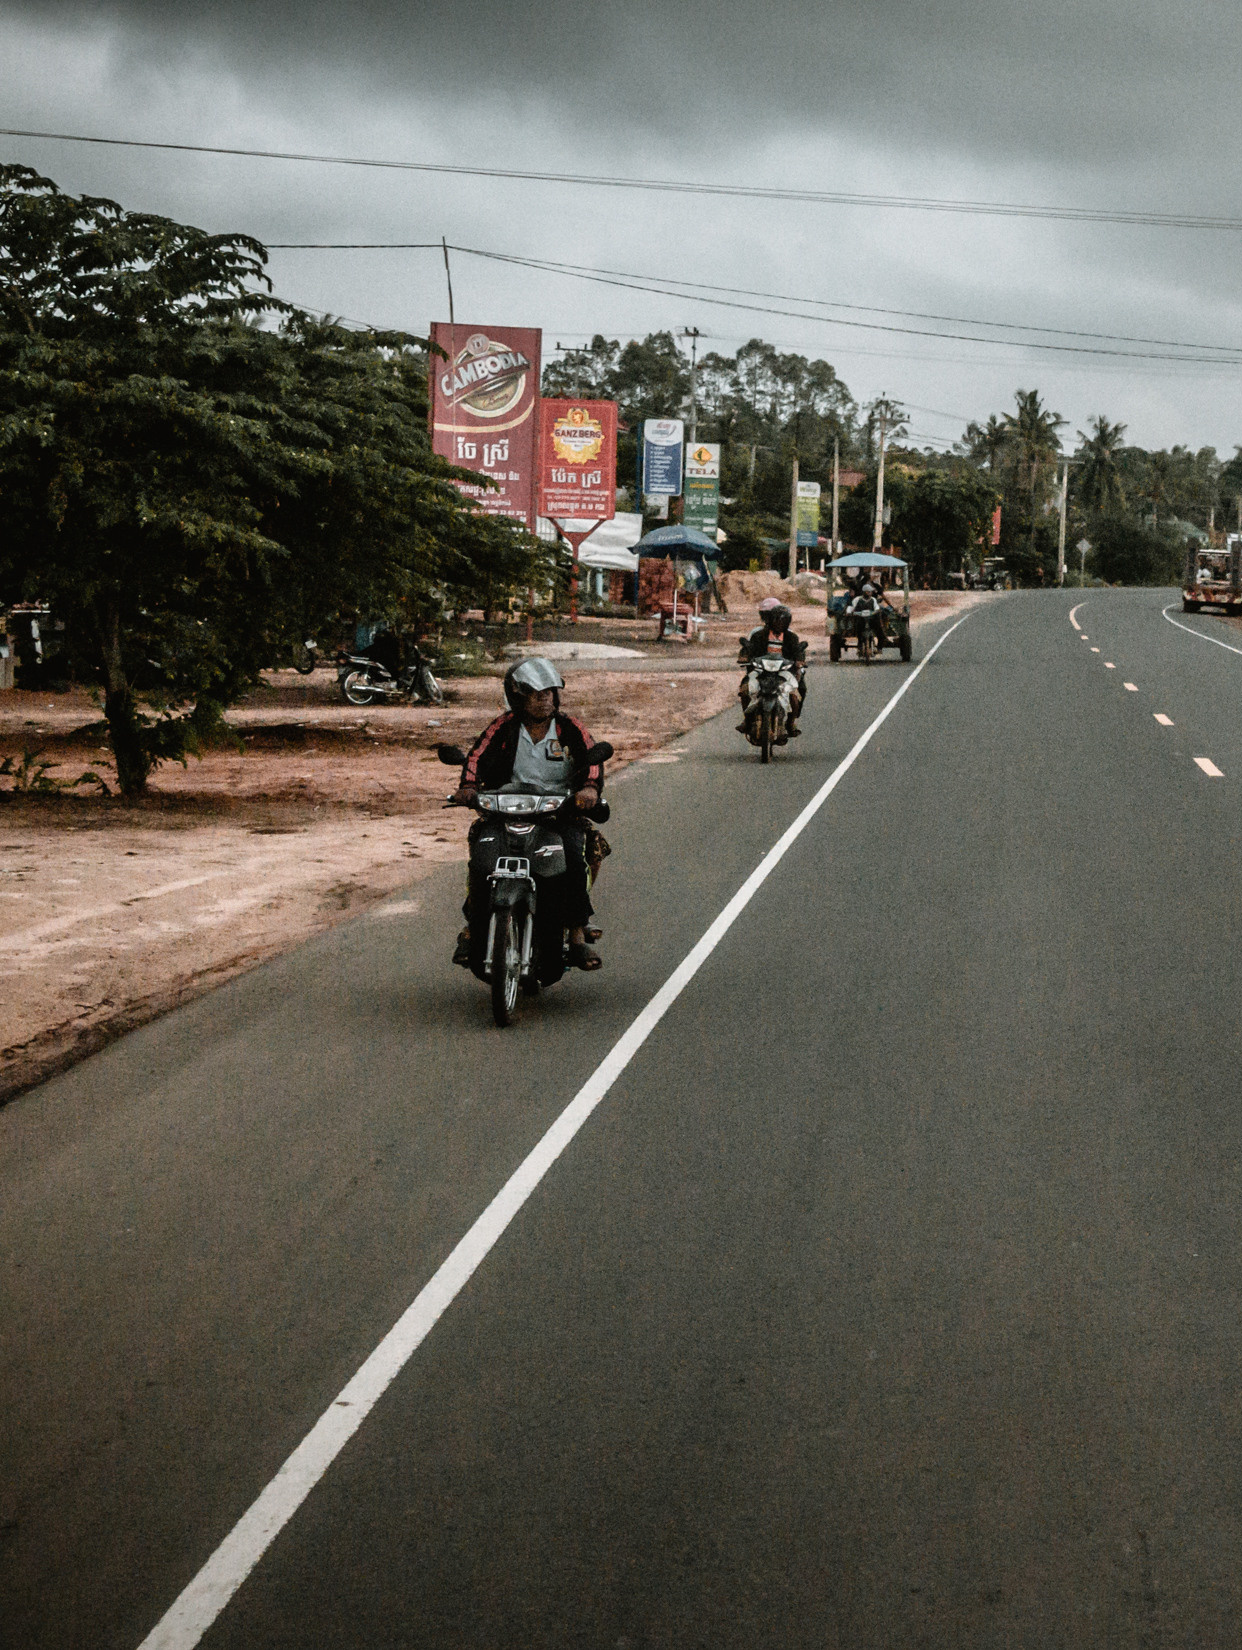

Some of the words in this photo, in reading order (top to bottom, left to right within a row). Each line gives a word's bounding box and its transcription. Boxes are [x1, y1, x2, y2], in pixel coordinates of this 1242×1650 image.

[441, 352, 529, 396] CAMBODIA
[554, 429, 602, 439] GANZBERG
[687, 467, 717, 476] TELA
